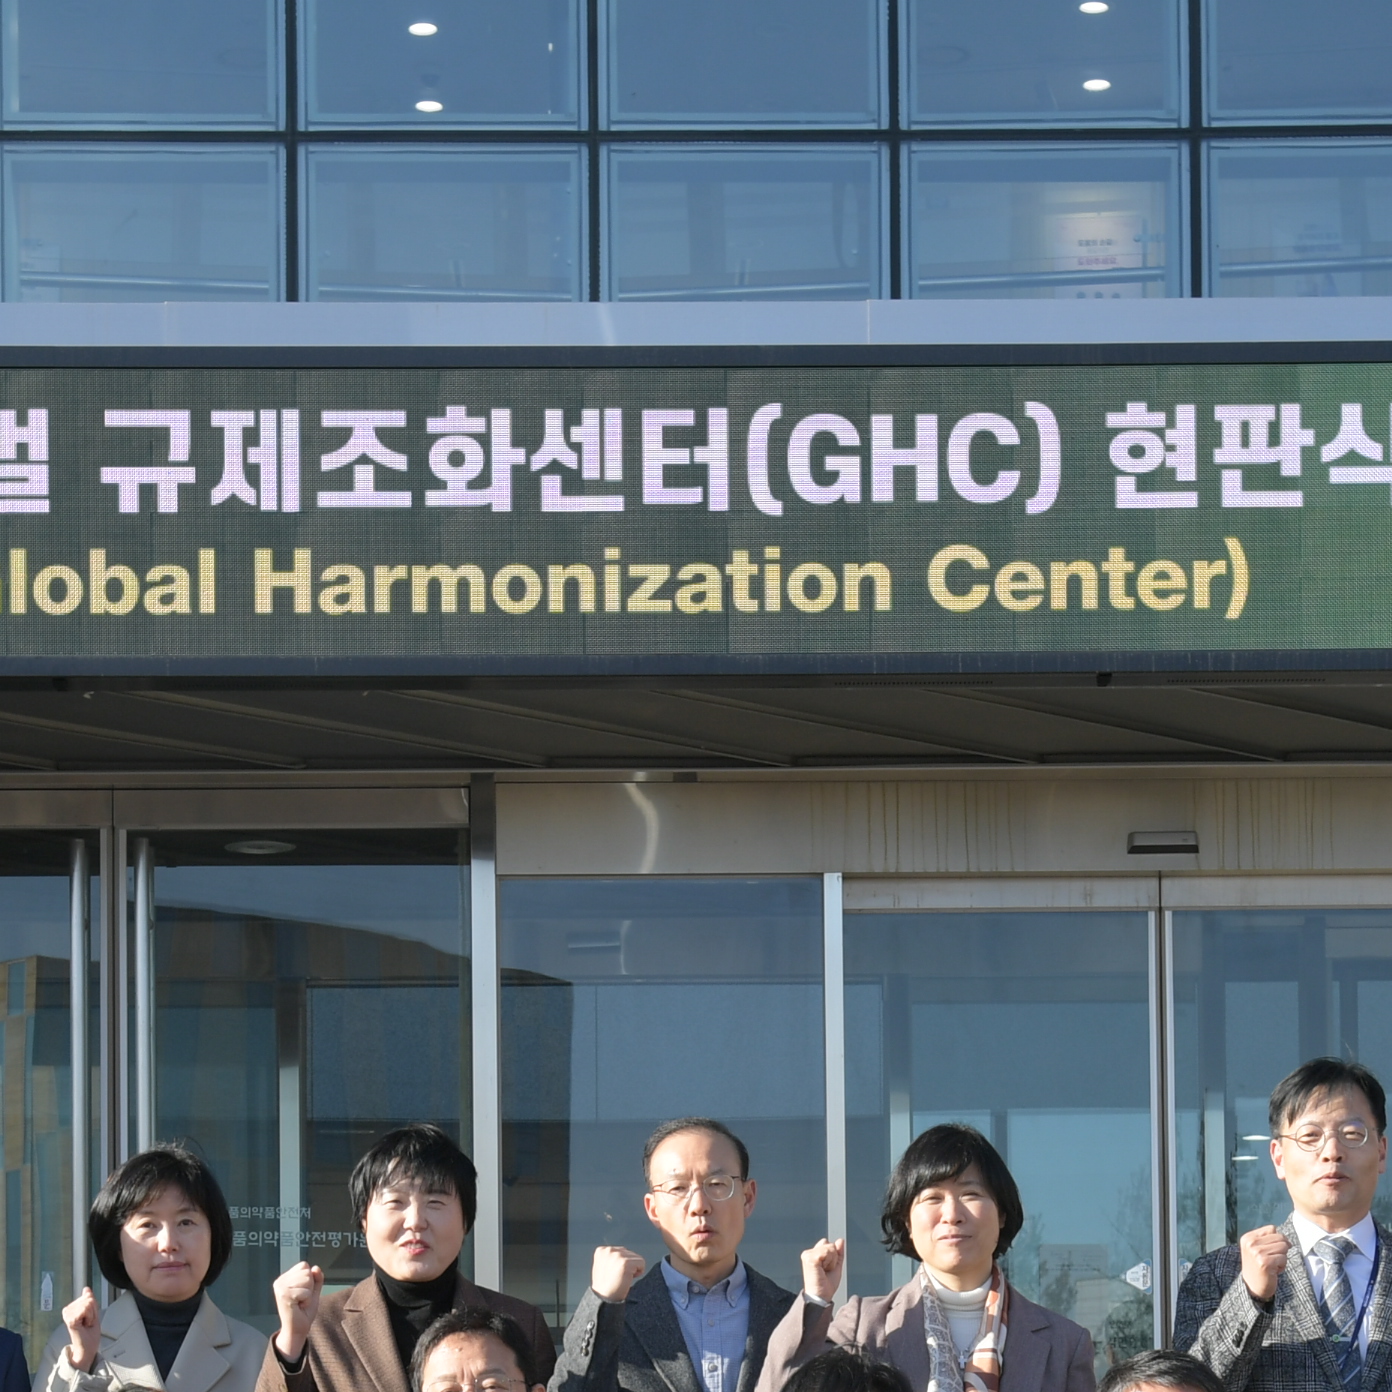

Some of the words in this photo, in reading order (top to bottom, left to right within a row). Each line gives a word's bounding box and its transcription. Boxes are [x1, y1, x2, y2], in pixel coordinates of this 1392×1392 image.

[99, 399, 1062, 517] 규제조화센터(GHC)
[254, 545, 892, 615] Harmonization
[927, 536, 1249, 620] Center)
